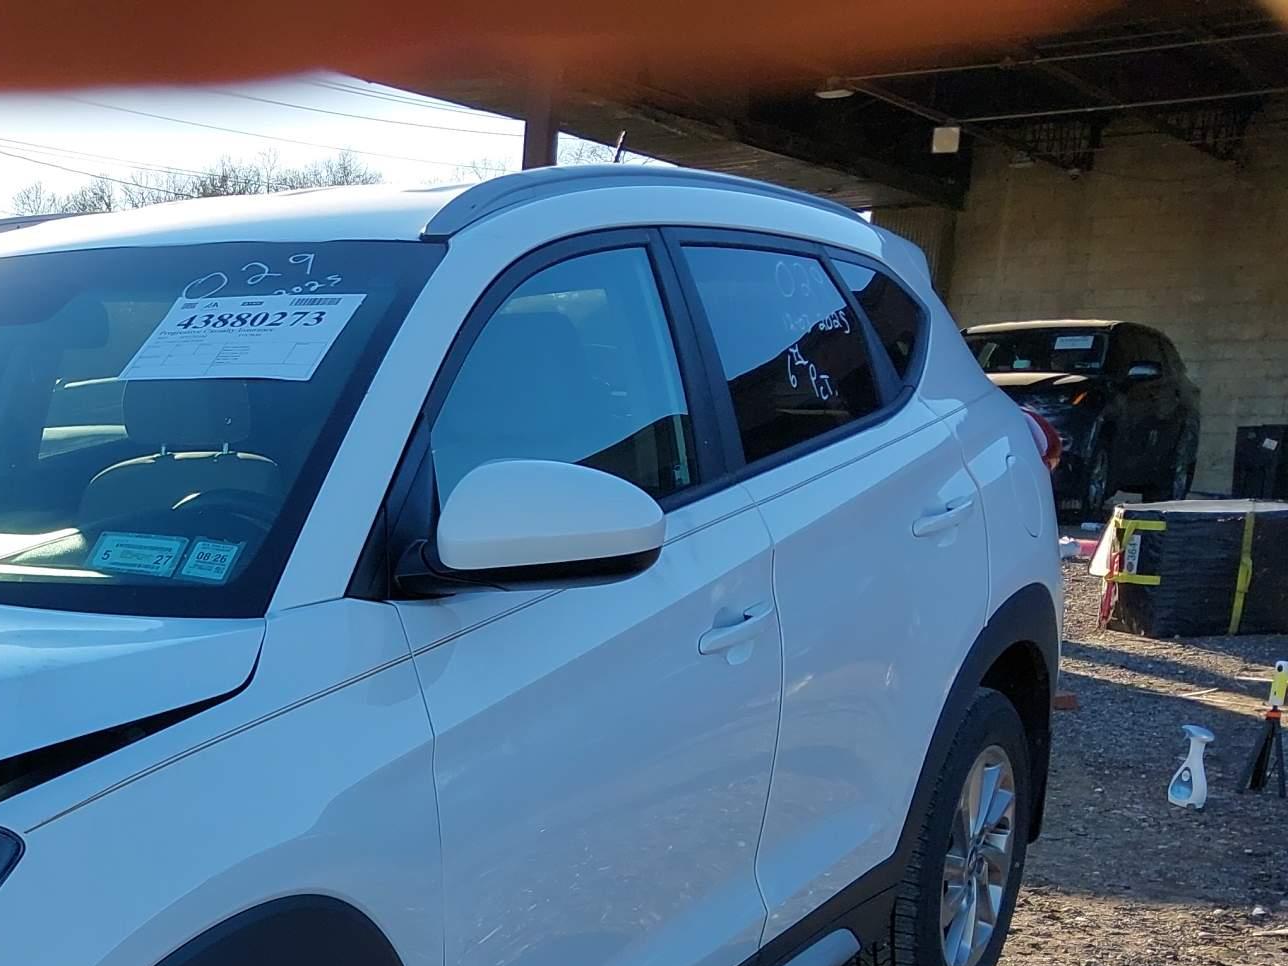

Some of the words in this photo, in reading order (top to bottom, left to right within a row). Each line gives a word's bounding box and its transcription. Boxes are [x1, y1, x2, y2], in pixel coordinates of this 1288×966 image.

[176, 311, 327, 330] 43880273
[101, 550, 113, 561] 5
[153, 554, 173, 566] 27
